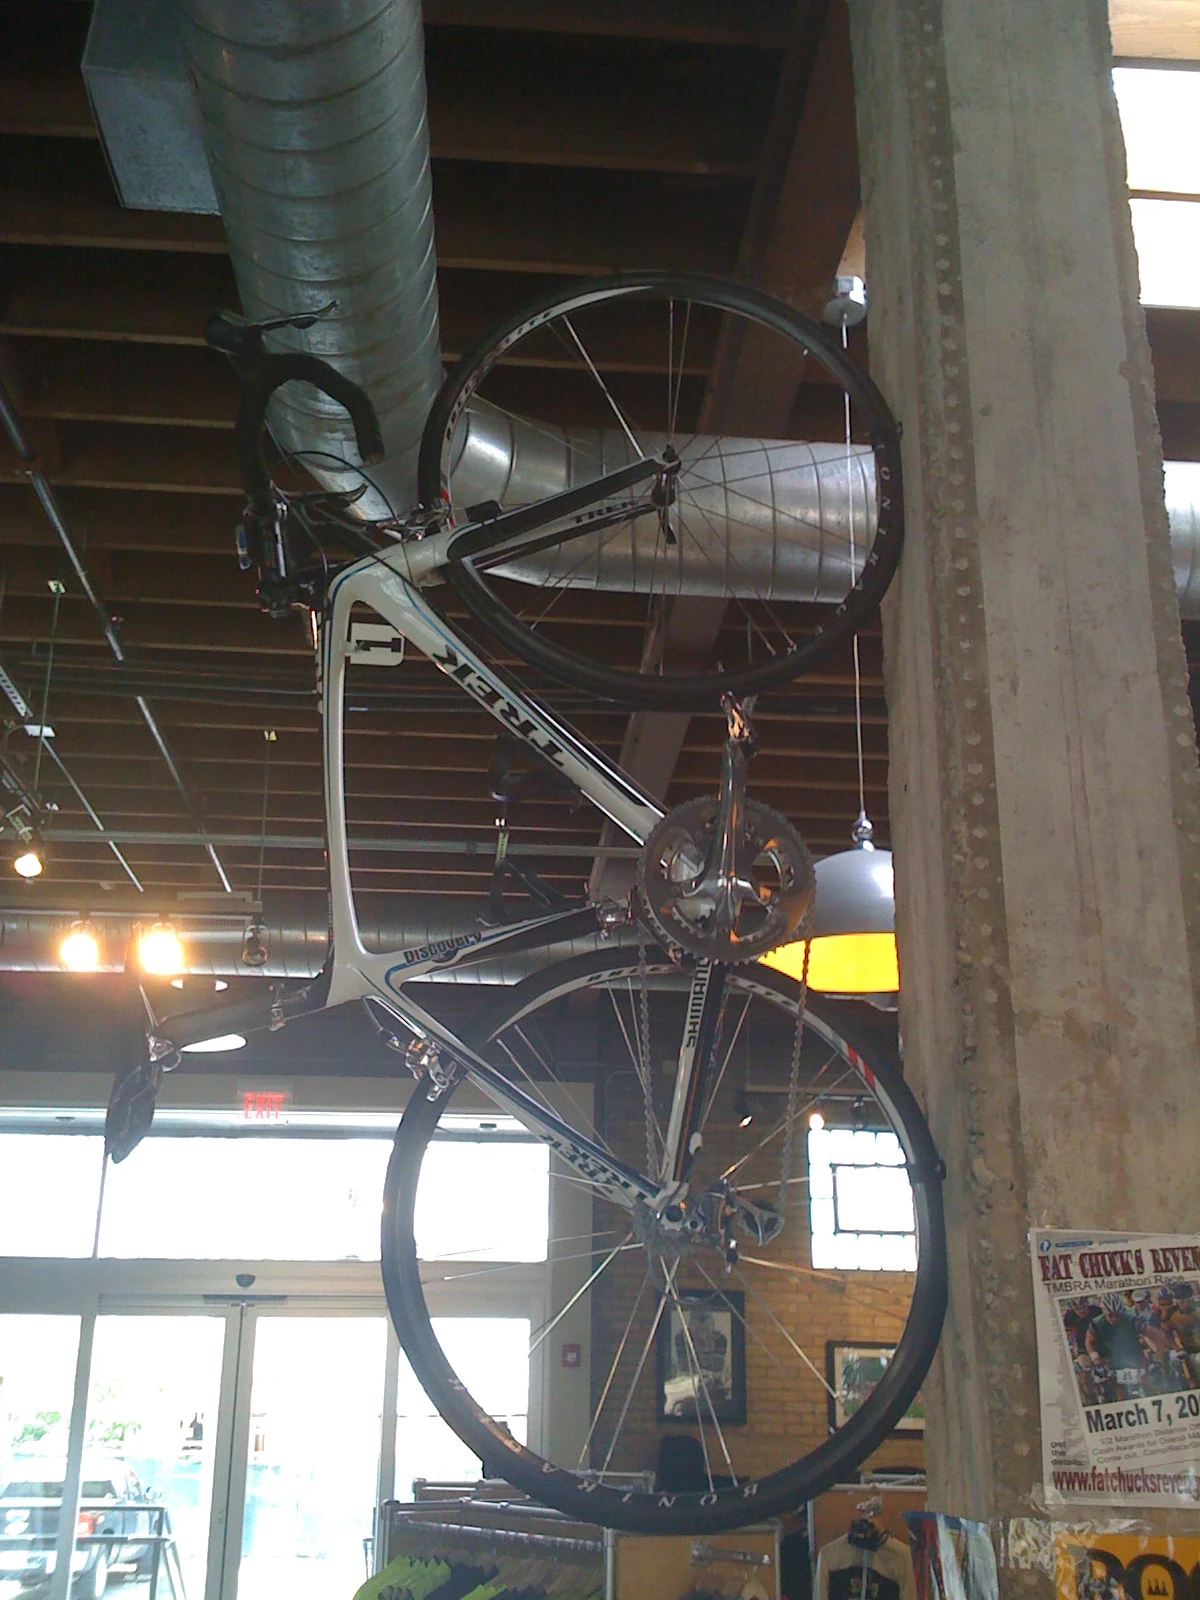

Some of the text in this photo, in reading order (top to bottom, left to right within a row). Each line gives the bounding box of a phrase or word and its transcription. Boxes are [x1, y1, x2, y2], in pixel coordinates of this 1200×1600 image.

[432, 643, 565, 768] TREK
[244, 1091, 285, 1119] EXIT
[1038, 1253, 1073, 1282] FAT
[1079, 1248, 1144, 1279] CHUCK'S
[1044, 1274, 1185, 1294] TMBRA Marathon Race
[1085, 1403, 1149, 1433] March
[1151, 1399, 1173, 1426] 7,
